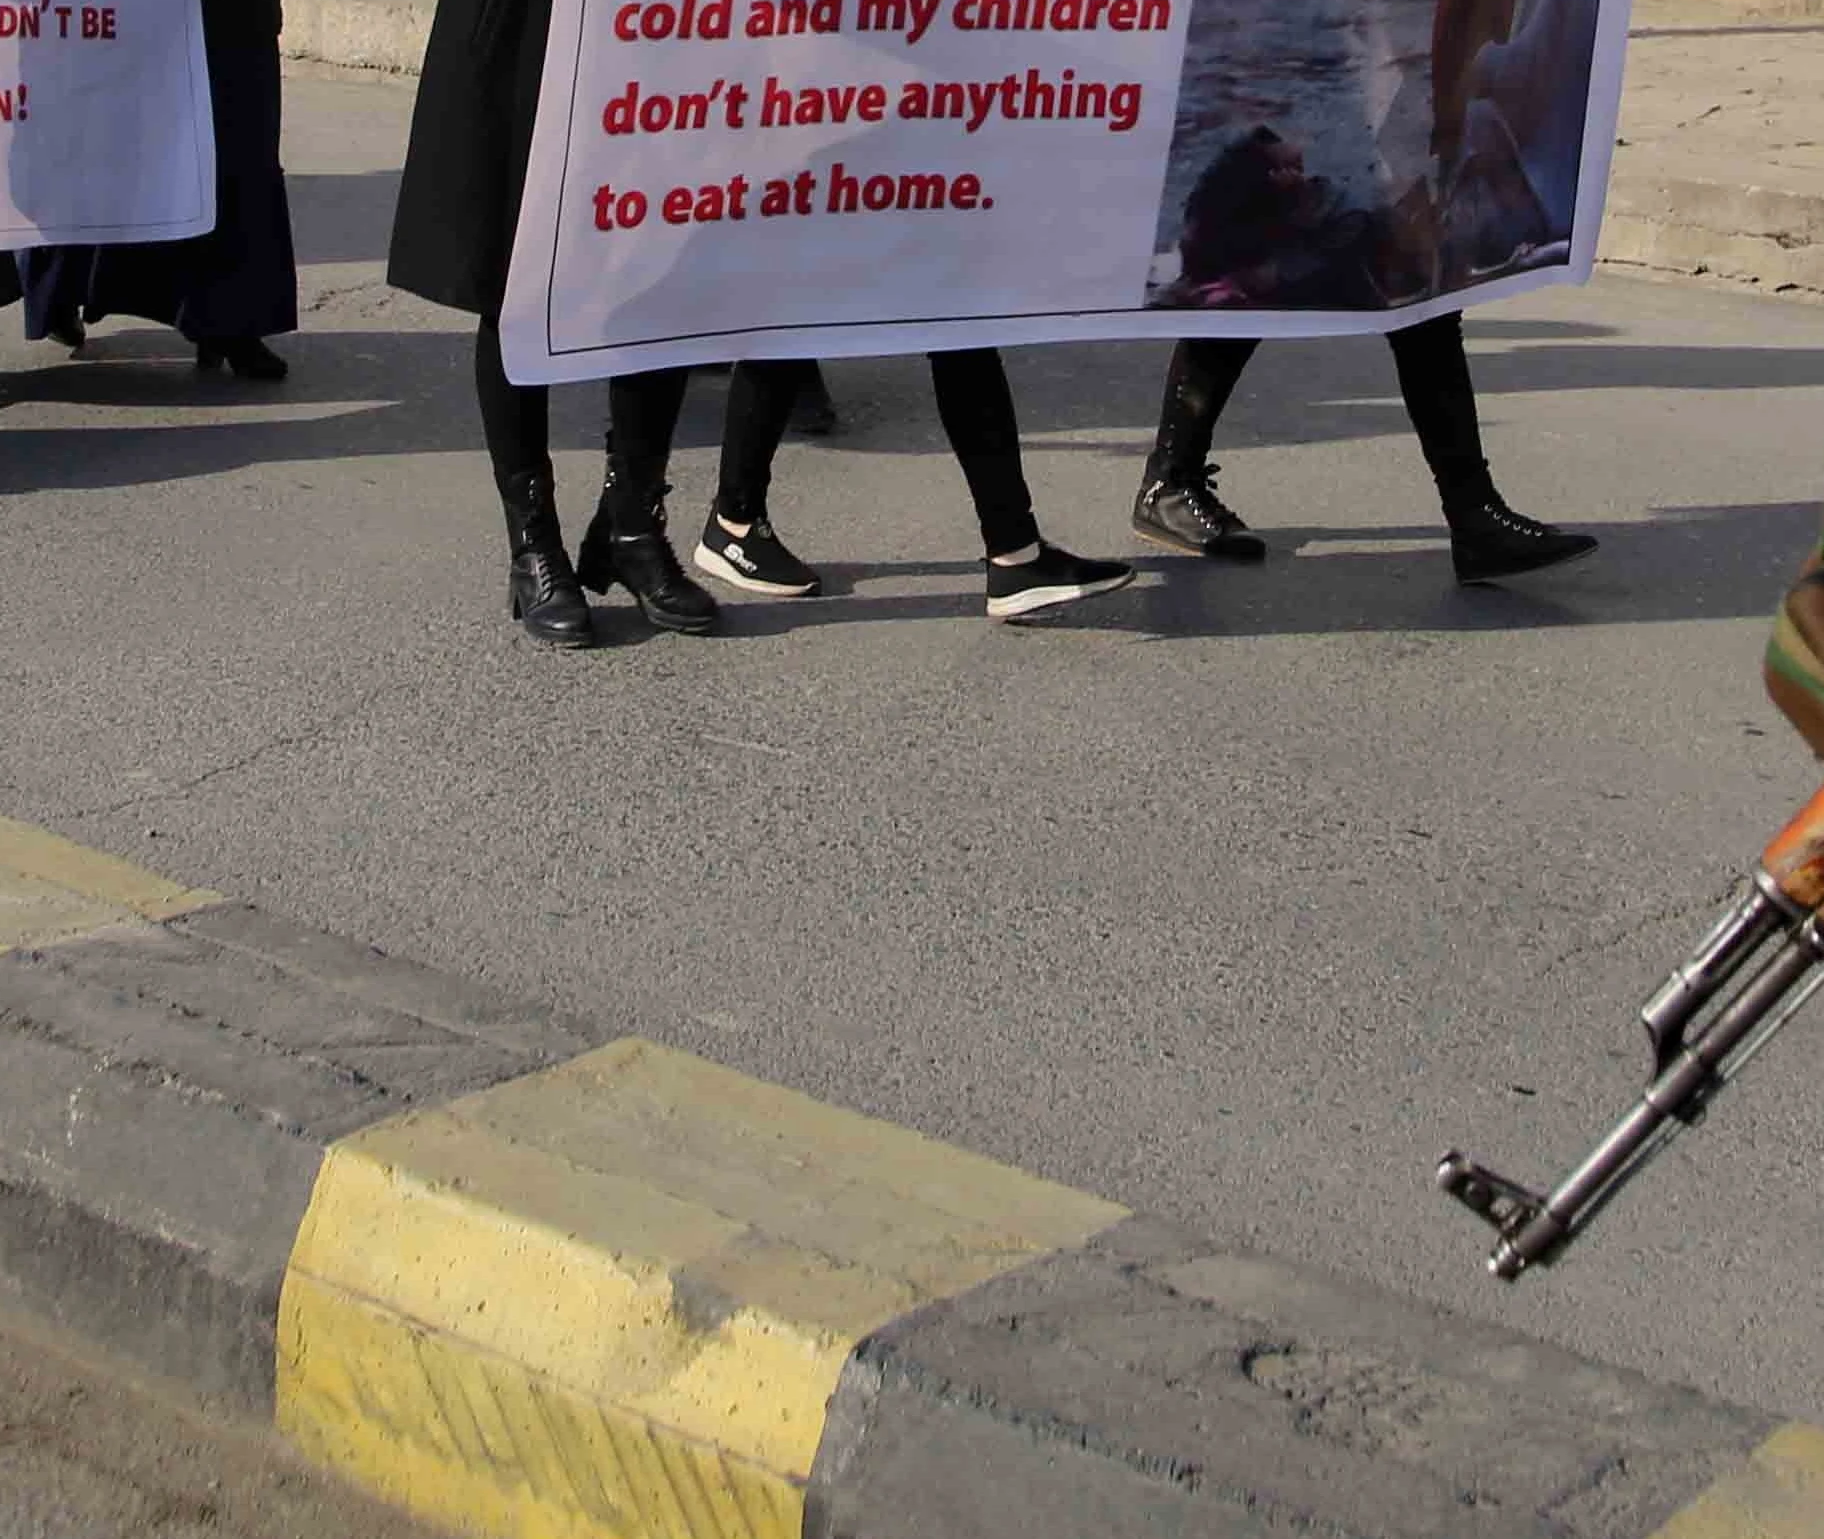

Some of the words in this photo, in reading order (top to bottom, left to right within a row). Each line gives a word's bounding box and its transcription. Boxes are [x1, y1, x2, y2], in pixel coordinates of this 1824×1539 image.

[82, 7, 117, 41] BE
[602, 79, 748, 135] don't
[759, 77, 887, 127] have
[897, 69, 1142, 132] anything
[592, 182, 648, 231] to
[661, 175, 749, 224] eat
[760, 169, 817, 214] at
[825, 163, 994, 214] home.
